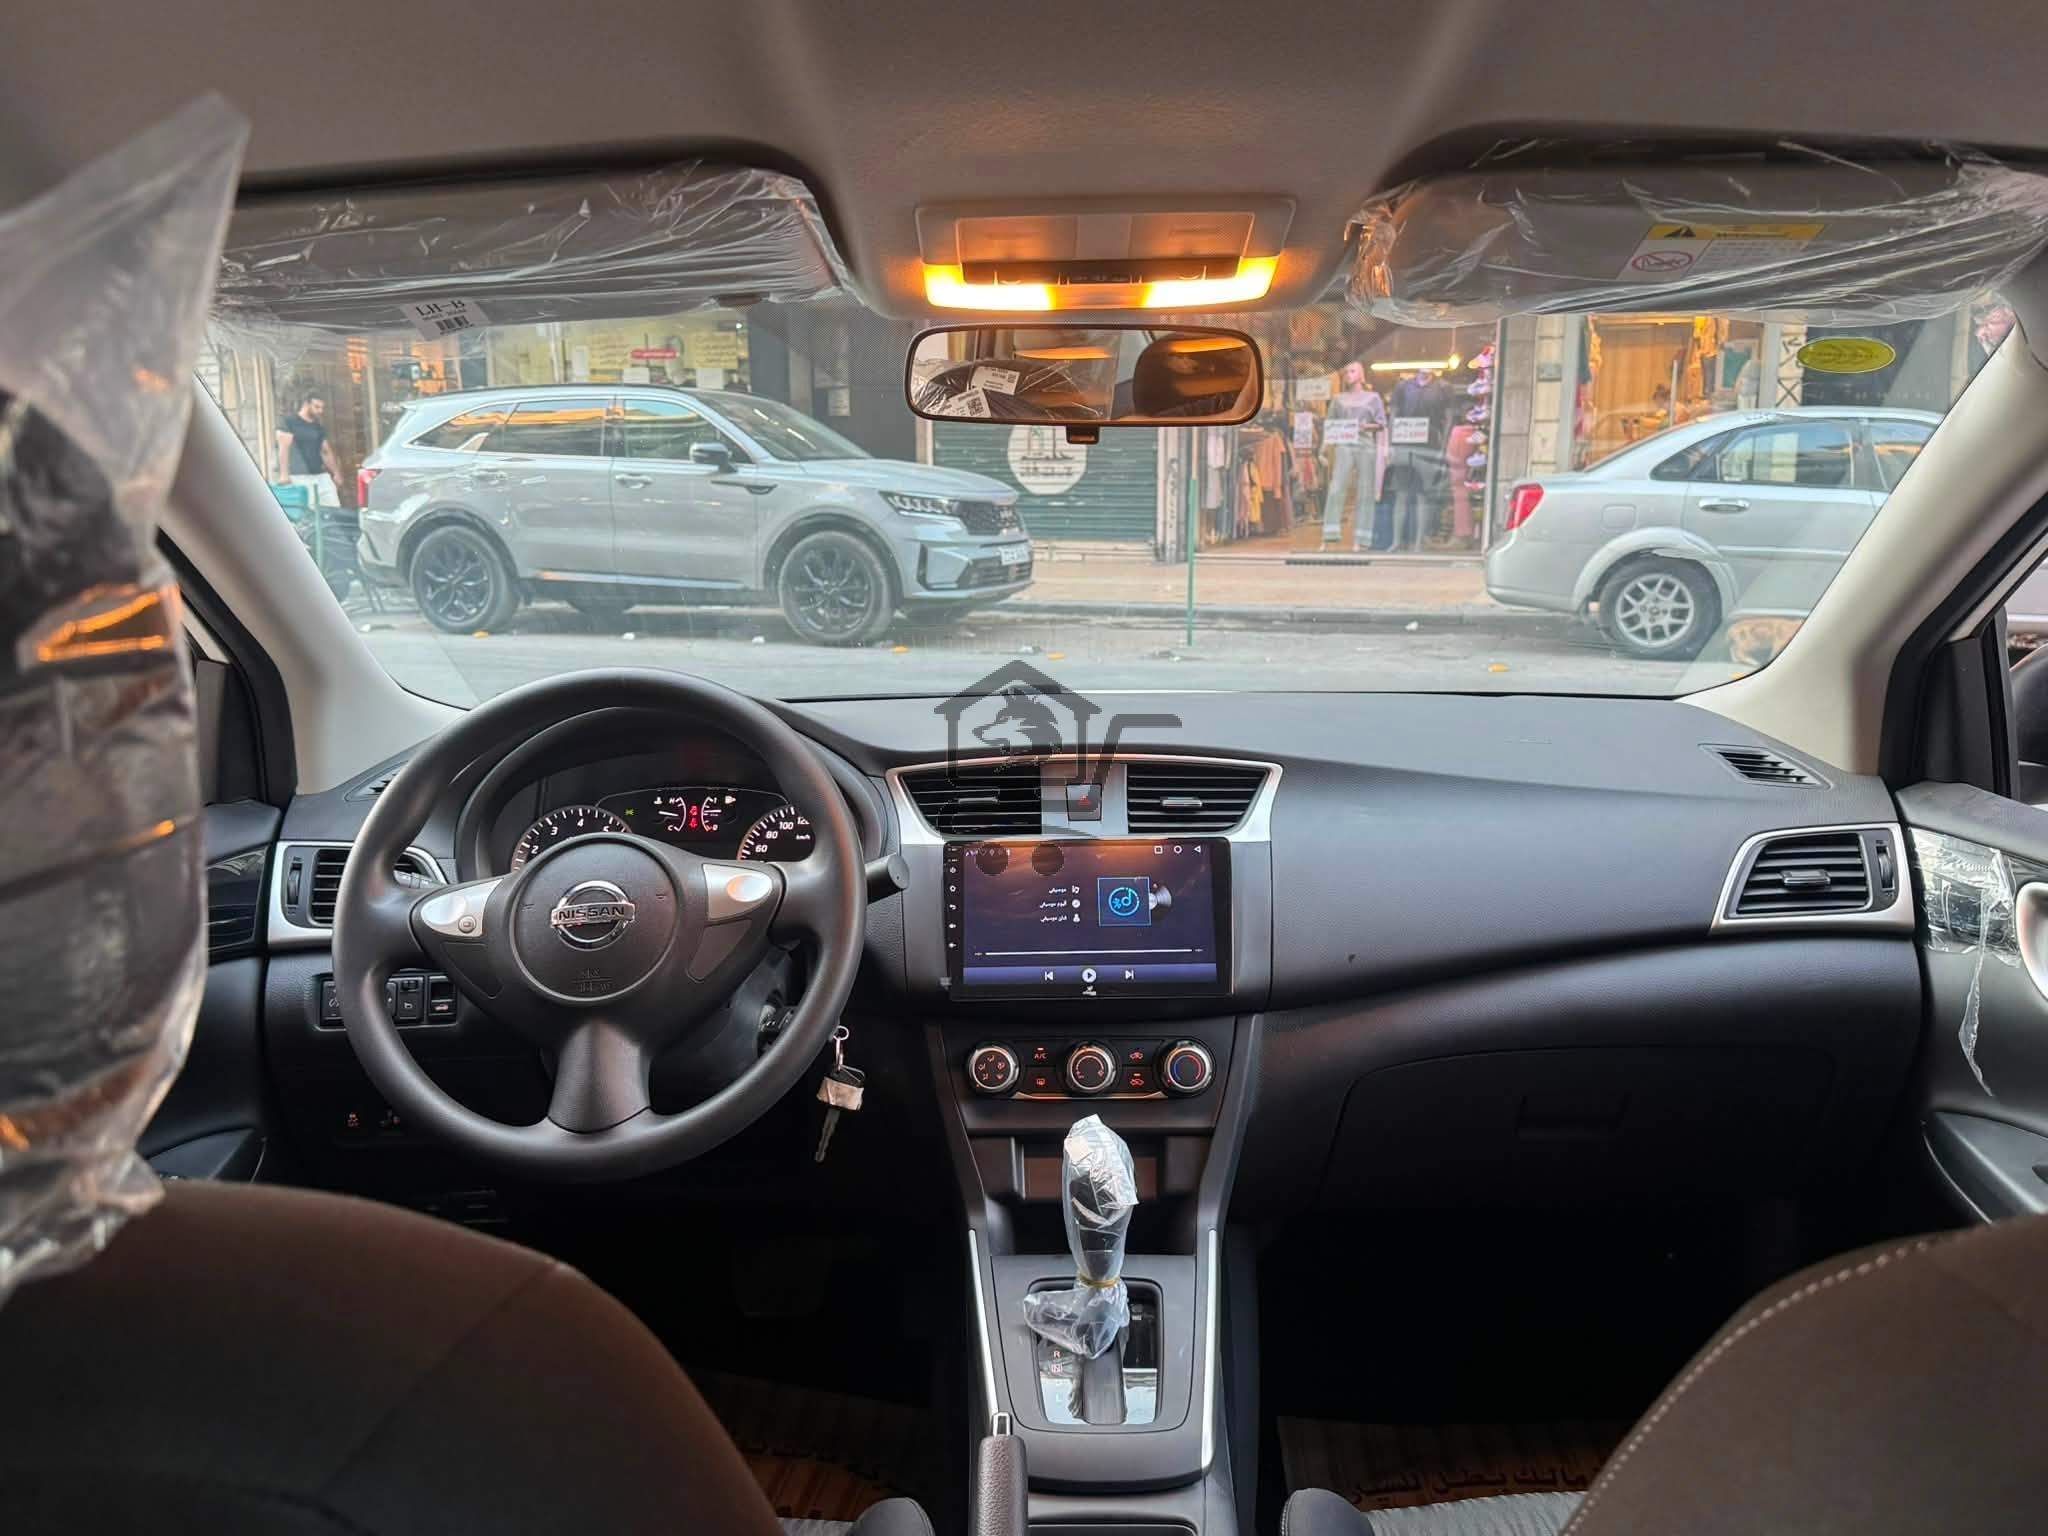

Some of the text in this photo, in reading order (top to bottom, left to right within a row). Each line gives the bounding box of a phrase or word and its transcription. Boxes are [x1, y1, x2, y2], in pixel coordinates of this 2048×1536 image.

[577, 818, 584, 827] 4
[779, 820, 794, 830] 100
[551, 827, 558, 835] 3
[765, 830, 778, 839] 80
[531, 845, 538, 854] 2
[755, 844, 768, 853] 60
[558, 905, 625, 921] NISSAN
